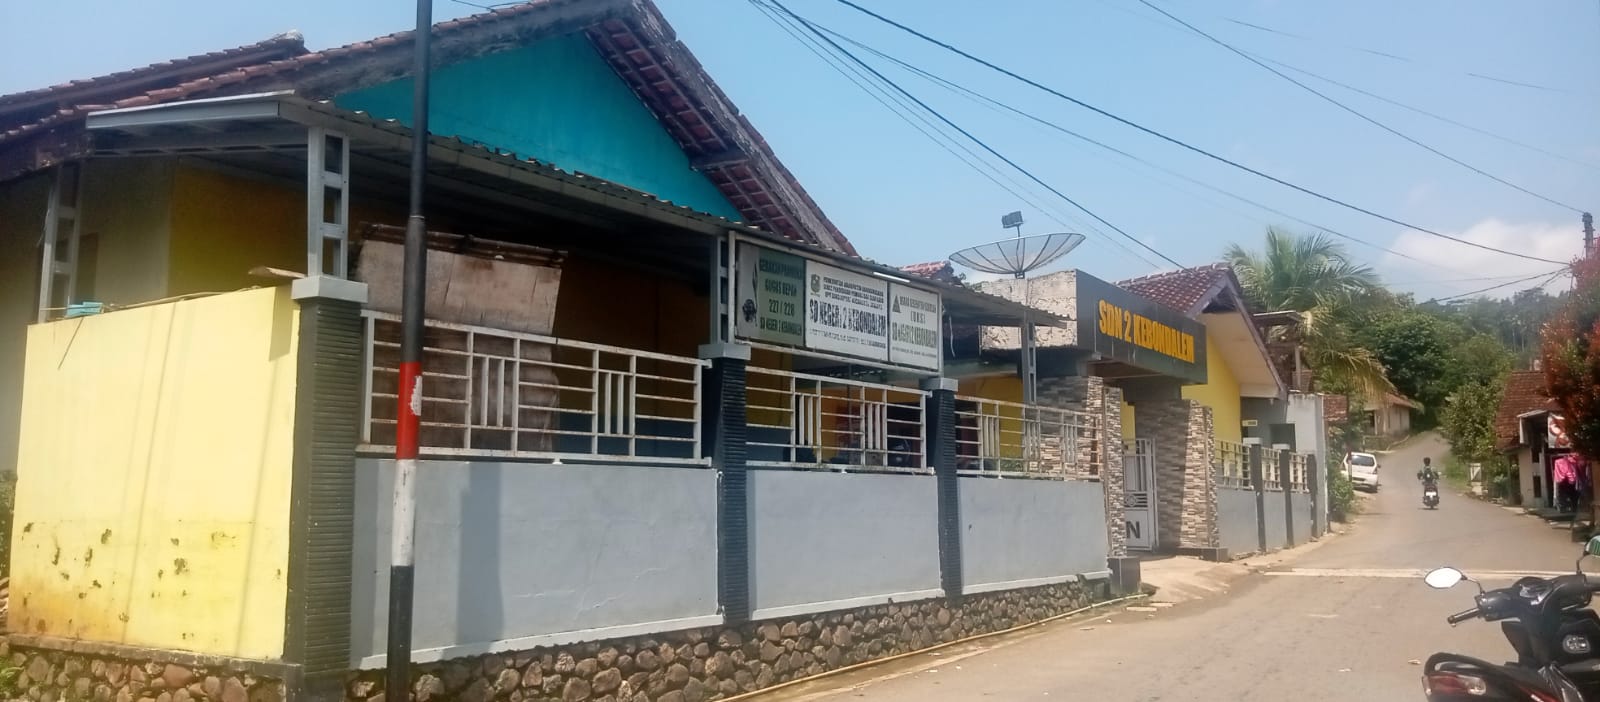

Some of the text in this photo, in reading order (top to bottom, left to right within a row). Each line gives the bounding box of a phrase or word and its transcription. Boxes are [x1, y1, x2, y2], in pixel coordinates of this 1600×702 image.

[769, 299, 779, 314] 227
[784, 302, 795, 317] 228
[810, 298, 819, 323] SD
[820, 302, 842, 329] NEGERI
[842, 307, 848, 329] 2
[848, 309, 887, 338] KEBONDALEM
[1099, 299, 1194, 363] SDN 2 KEBONDALEM
